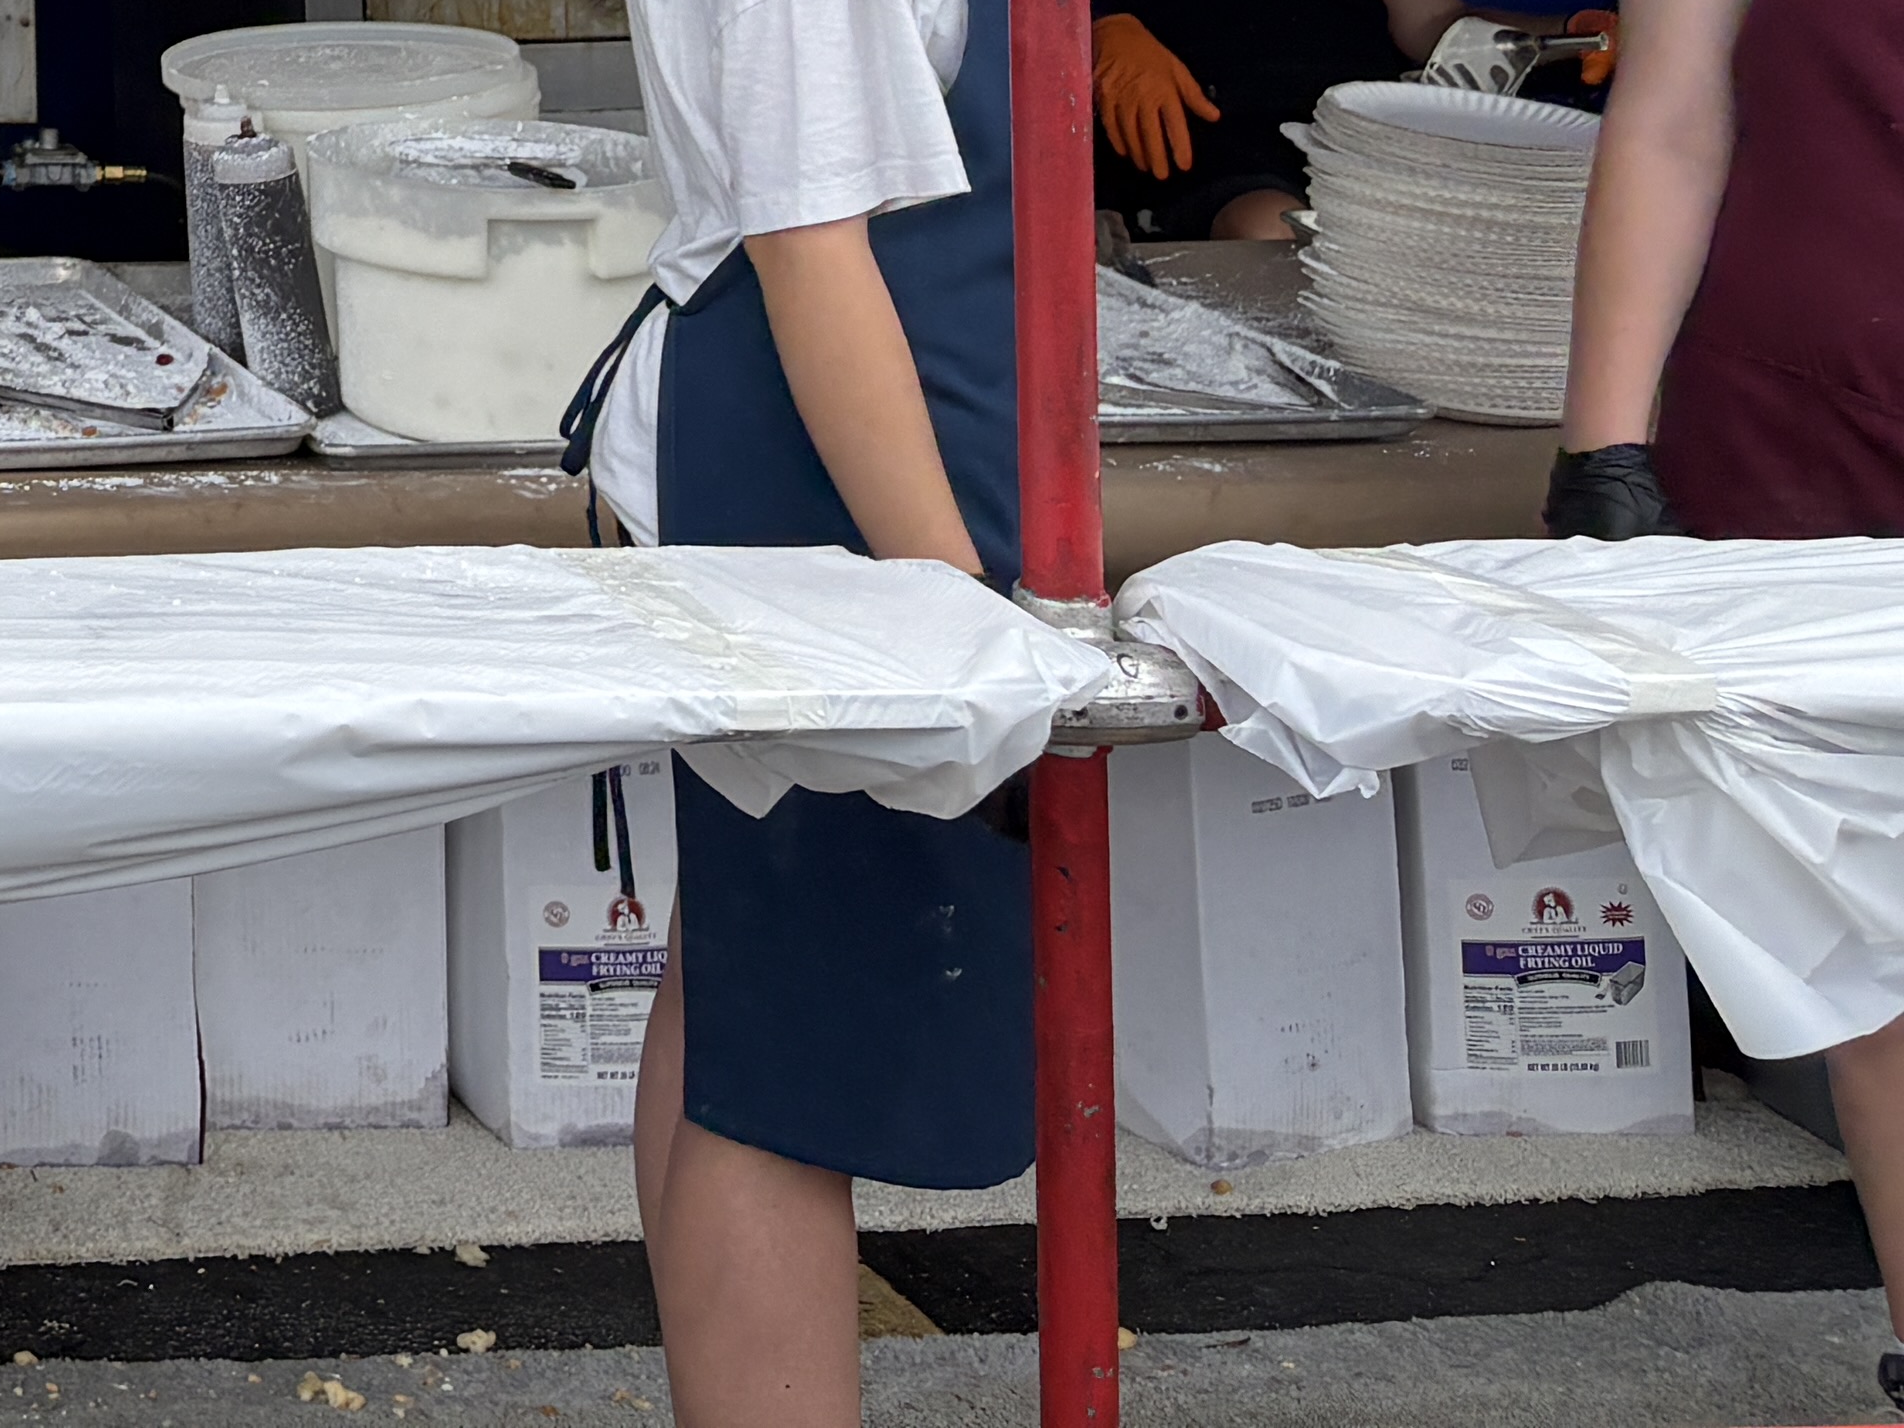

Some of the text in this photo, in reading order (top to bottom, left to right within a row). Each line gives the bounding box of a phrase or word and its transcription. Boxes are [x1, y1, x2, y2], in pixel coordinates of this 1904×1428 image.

[1518, 944, 1574, 956] CREAMY
[1576, 943, 1623, 957] LIQUID
[591, 952, 645, 963] CREAMY
[647, 951, 668, 963] LIQ
[1519, 956, 1596, 969] FRYING OIL
[592, 963, 663, 976] FRYING OIL
